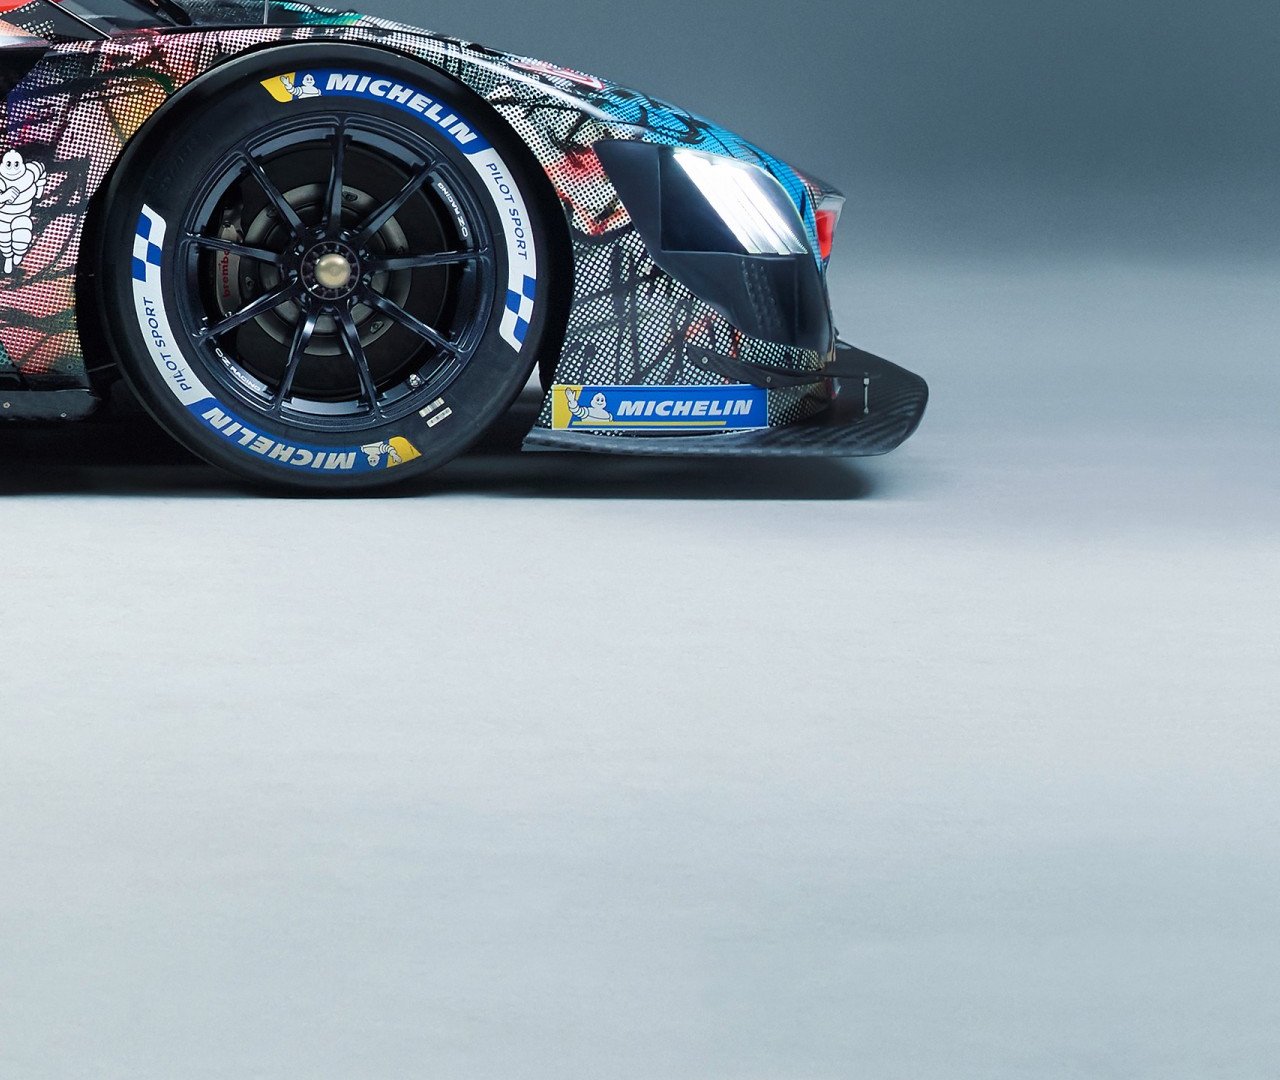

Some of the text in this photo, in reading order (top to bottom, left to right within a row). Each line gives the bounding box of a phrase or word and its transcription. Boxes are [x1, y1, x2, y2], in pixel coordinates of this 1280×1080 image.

[325, 73, 479, 145] MICHELIN
[485, 162, 529, 260] PILOT SPORT
[143, 297, 192, 391] PILOT SPORT
[201, 407, 357, 469] MICHELIN
[617, 400, 753, 416] MICHELIN
